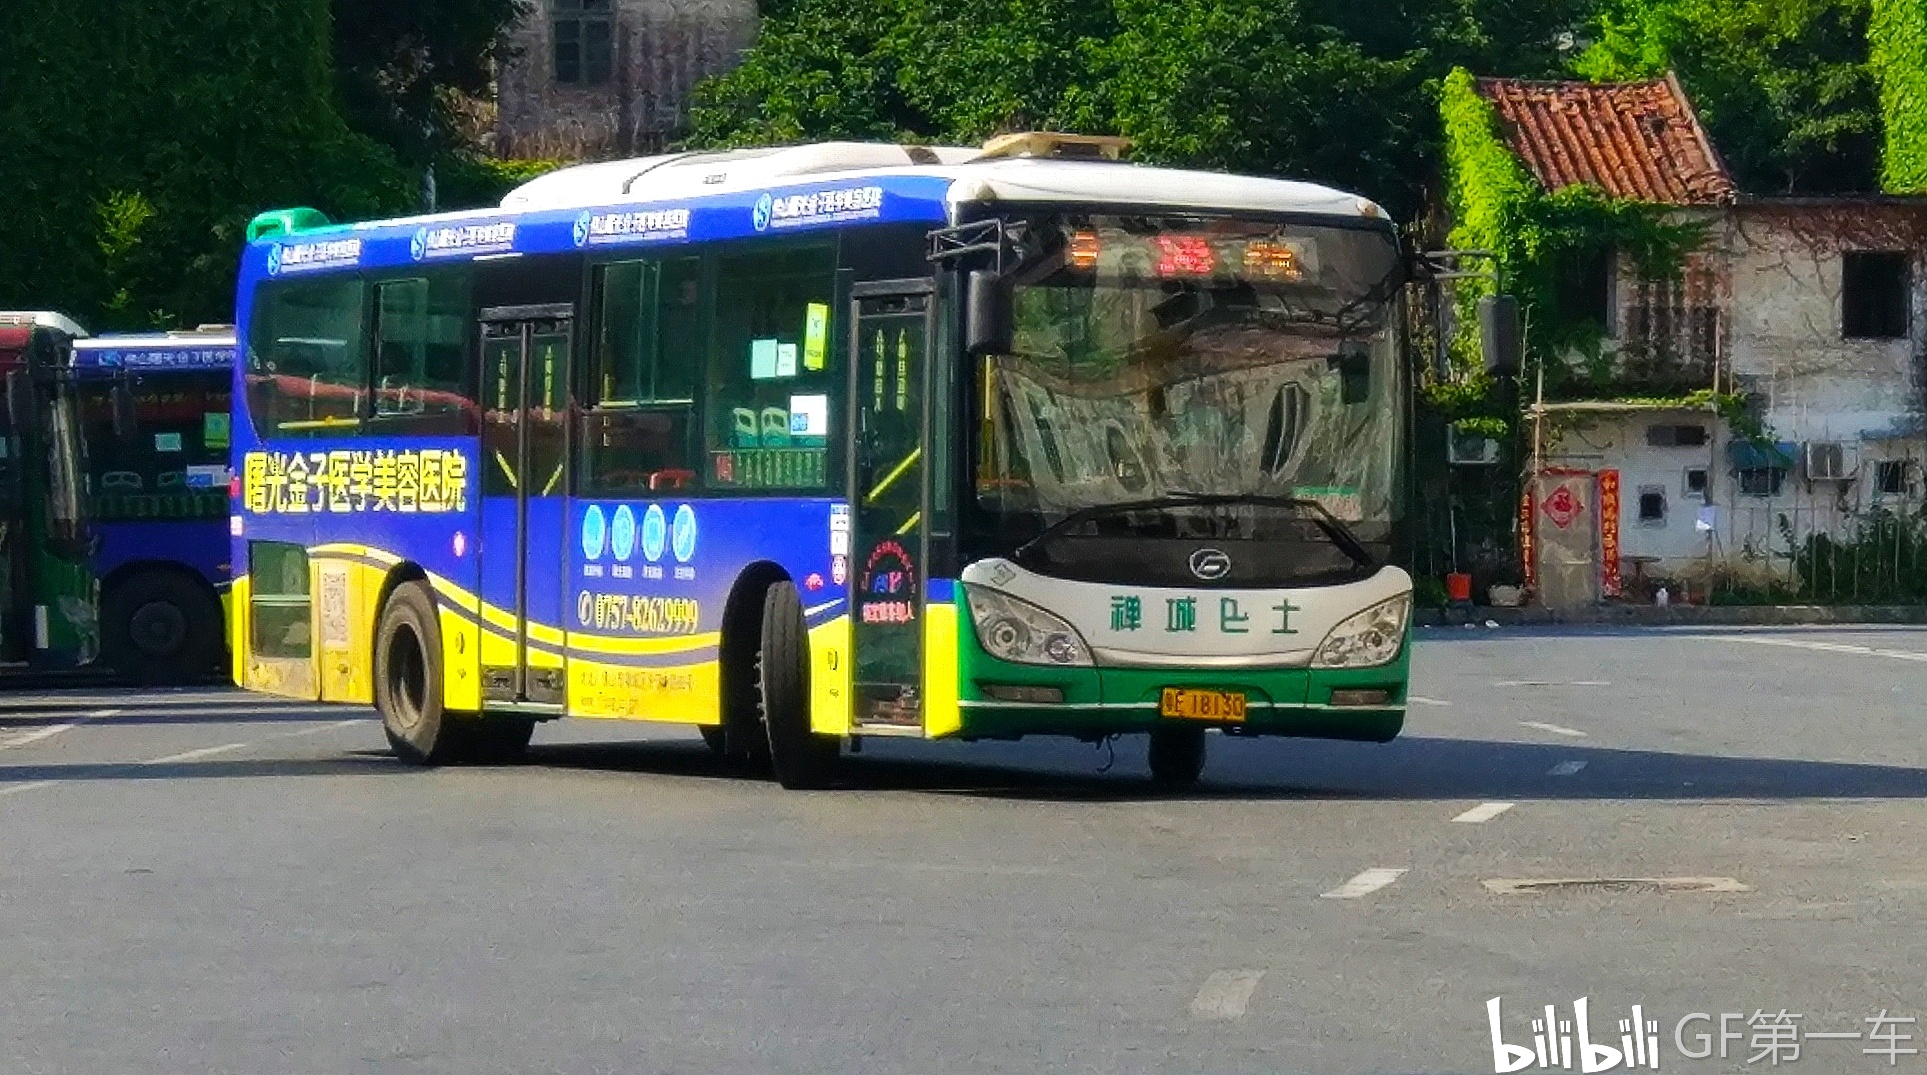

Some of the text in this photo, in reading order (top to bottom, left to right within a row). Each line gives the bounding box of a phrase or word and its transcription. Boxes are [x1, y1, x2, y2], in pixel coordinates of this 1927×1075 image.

[244, 449, 466, 512] 曙光金子医学美容医院
[1109, 594, 1301, 634] 禅城巴士
